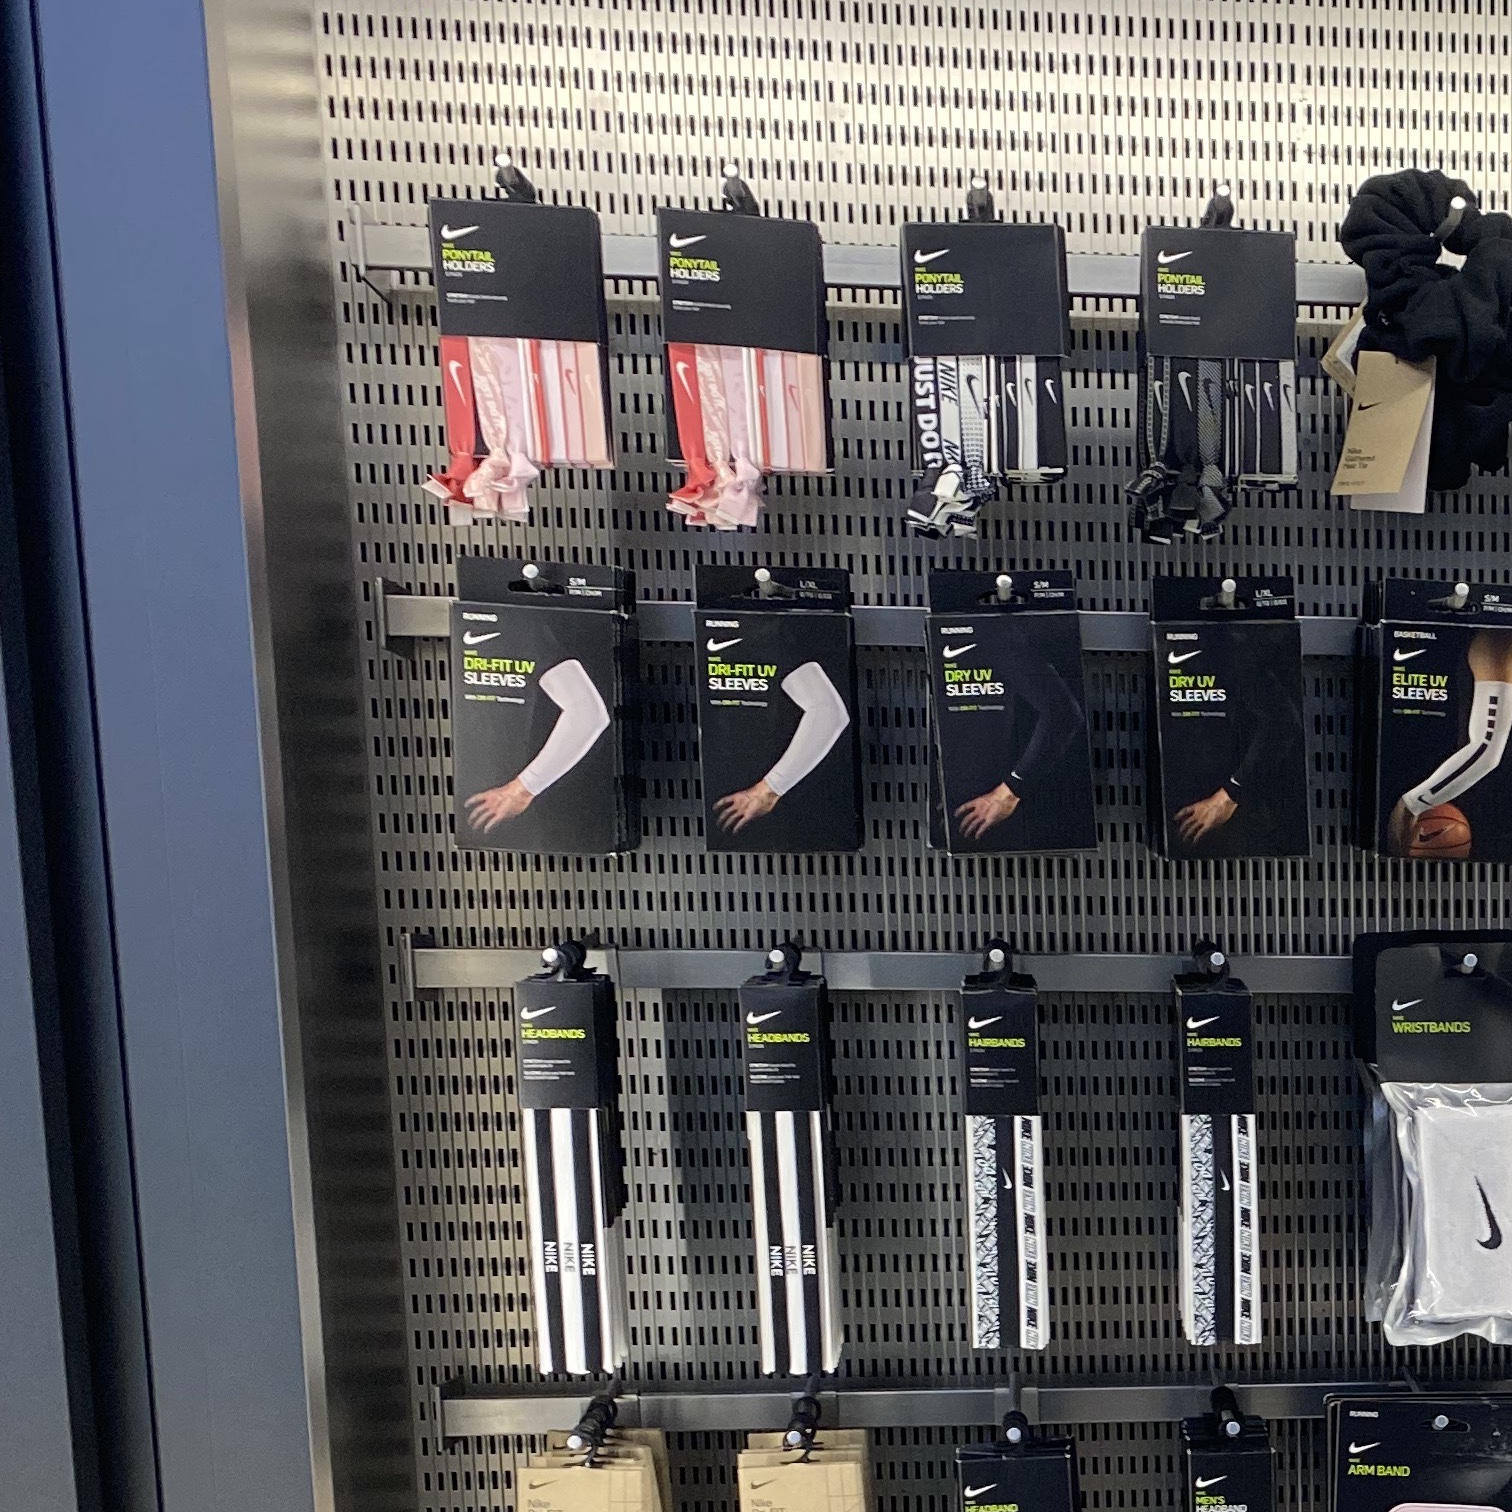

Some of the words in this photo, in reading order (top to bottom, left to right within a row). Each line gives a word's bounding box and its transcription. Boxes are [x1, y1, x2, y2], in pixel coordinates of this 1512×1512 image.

[442, 249, 496, 262] PONYTAIL
[442, 260, 496, 273] HOLDERS
[670, 257, 721, 271] PONYTAIL
[670, 268, 721, 282] HOLDERS
[915, 273, 965, 284] PONYTAIL
[1158, 273, 1206, 285] PONYTAIL
[915, 283, 964, 294] HOLDERS
[1157, 283, 1206, 296] HOLDERS
[939, 361, 959, 408] NIKE
[464, 657, 513, 672] DRI-FIT
[516, 661, 536, 674] UV
[708, 663, 755, 676] DRI-FIT
[758, 665, 777, 677] UV
[463, 672, 527, 688] SLEEVES
[945, 669, 972, 682] DRY
[973, 669, 992, 681] UV
[1169, 676, 1195, 688] DRY
[1197, 675, 1216, 688] UV
[1393, 673, 1428, 686] ELITE
[1430, 675, 1448, 687] UV
[708, 678, 768, 691] SLEEVES
[946, 682, 1005, 696] SLEEVES
[1169, 689, 1227, 702] SLEEVES
[1392, 687, 1448, 701] SLEEVES
[521, 1028, 586, 1039] HEADBANDS
[1392, 1021, 1471, 1034] WRISTBANDS
[747, 1033, 811, 1043] HEADBANDS
[968, 1037, 1026, 1048] HAIRBANDS
[1186, 1037, 1242, 1047] HAIRBANDS
[544, 1241, 558, 1273] NIKE
[563, 1241, 576, 1273] NIKE
[581, 1243, 596, 1276] NIKE
[770, 1245, 784, 1276] NIKE
[802, 1244, 816, 1275] NIKE
[1348, 1464, 1375, 1476] ARM
[1376, 1465, 1411, 1477] BAND
[528, 1499, 550, 1508] Nike
[751, 1499, 773, 1507] Nike
[1195, 1504, 1248, 1512] HEADBAND
